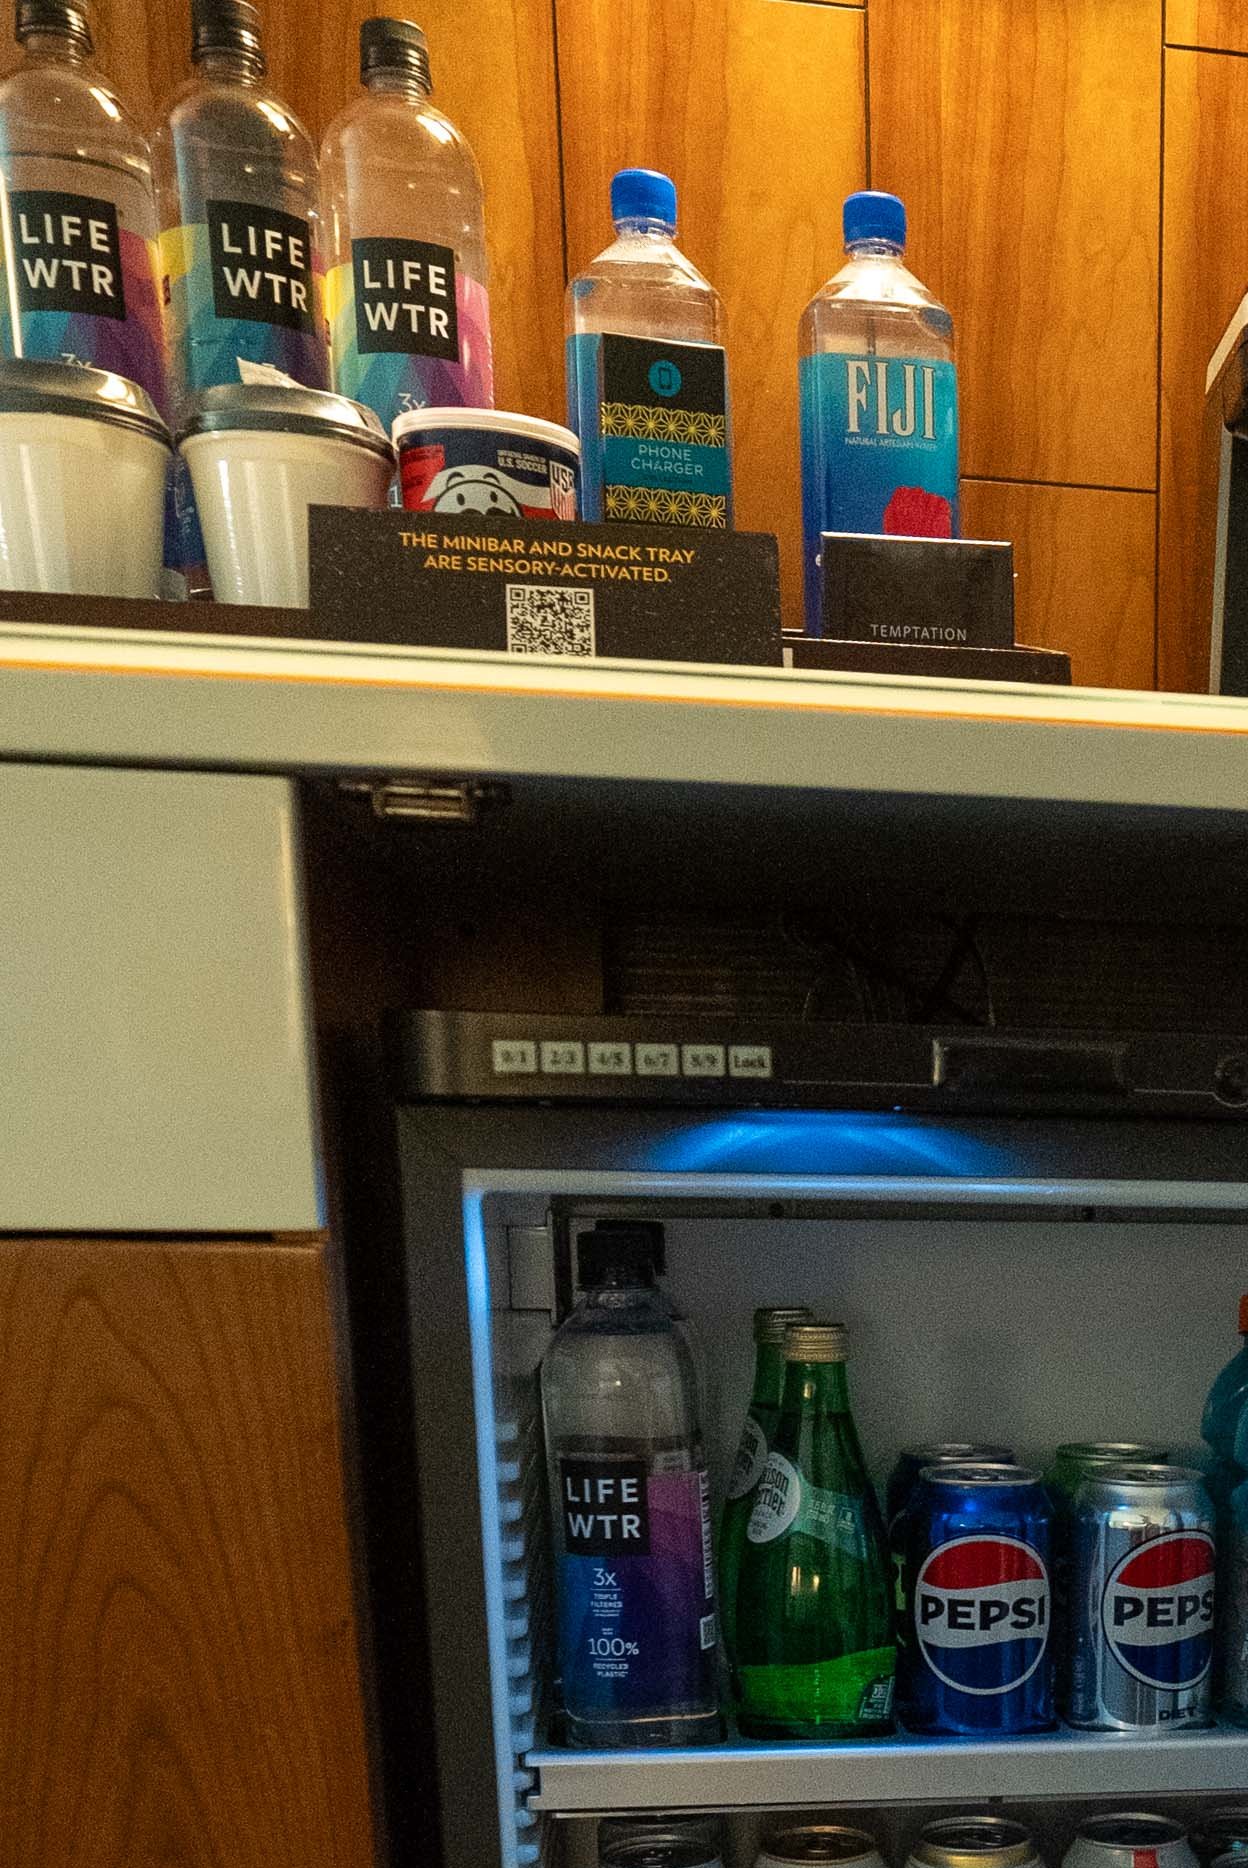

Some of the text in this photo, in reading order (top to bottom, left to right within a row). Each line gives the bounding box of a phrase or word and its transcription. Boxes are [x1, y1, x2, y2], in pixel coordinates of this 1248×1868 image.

[19, 213, 112, 252] LIFE
[221, 222, 305, 269] LIFE
[22, 258, 115, 297] WTR
[223, 266, 308, 313] WTR
[362, 259, 448, 296] LIFE
[363, 302, 450, 340] WTR
[845, 359, 937, 440] FIJI
[631, 457, 704, 476] CHARGER
[638, 444, 692, 461] PHONE
[399, 531, 695, 564] THE MINIBAR AND SNACK TRAY
[423, 554, 672, 583] ARE SENSORY-ACTIVATED.
[870, 624, 967, 642] TEMPTATION
[566, 1477, 640, 1504] LIFE
[568, 1512, 642, 1539] WTR
[593, 1567, 617, 1587] 3x
[920, 1594, 1045, 1631] PEPSI
[1113, 1588, 1214, 1627] PEPS
[588, 1638, 640, 1656] 100%
[1159, 1706, 1196, 1720] DIET
